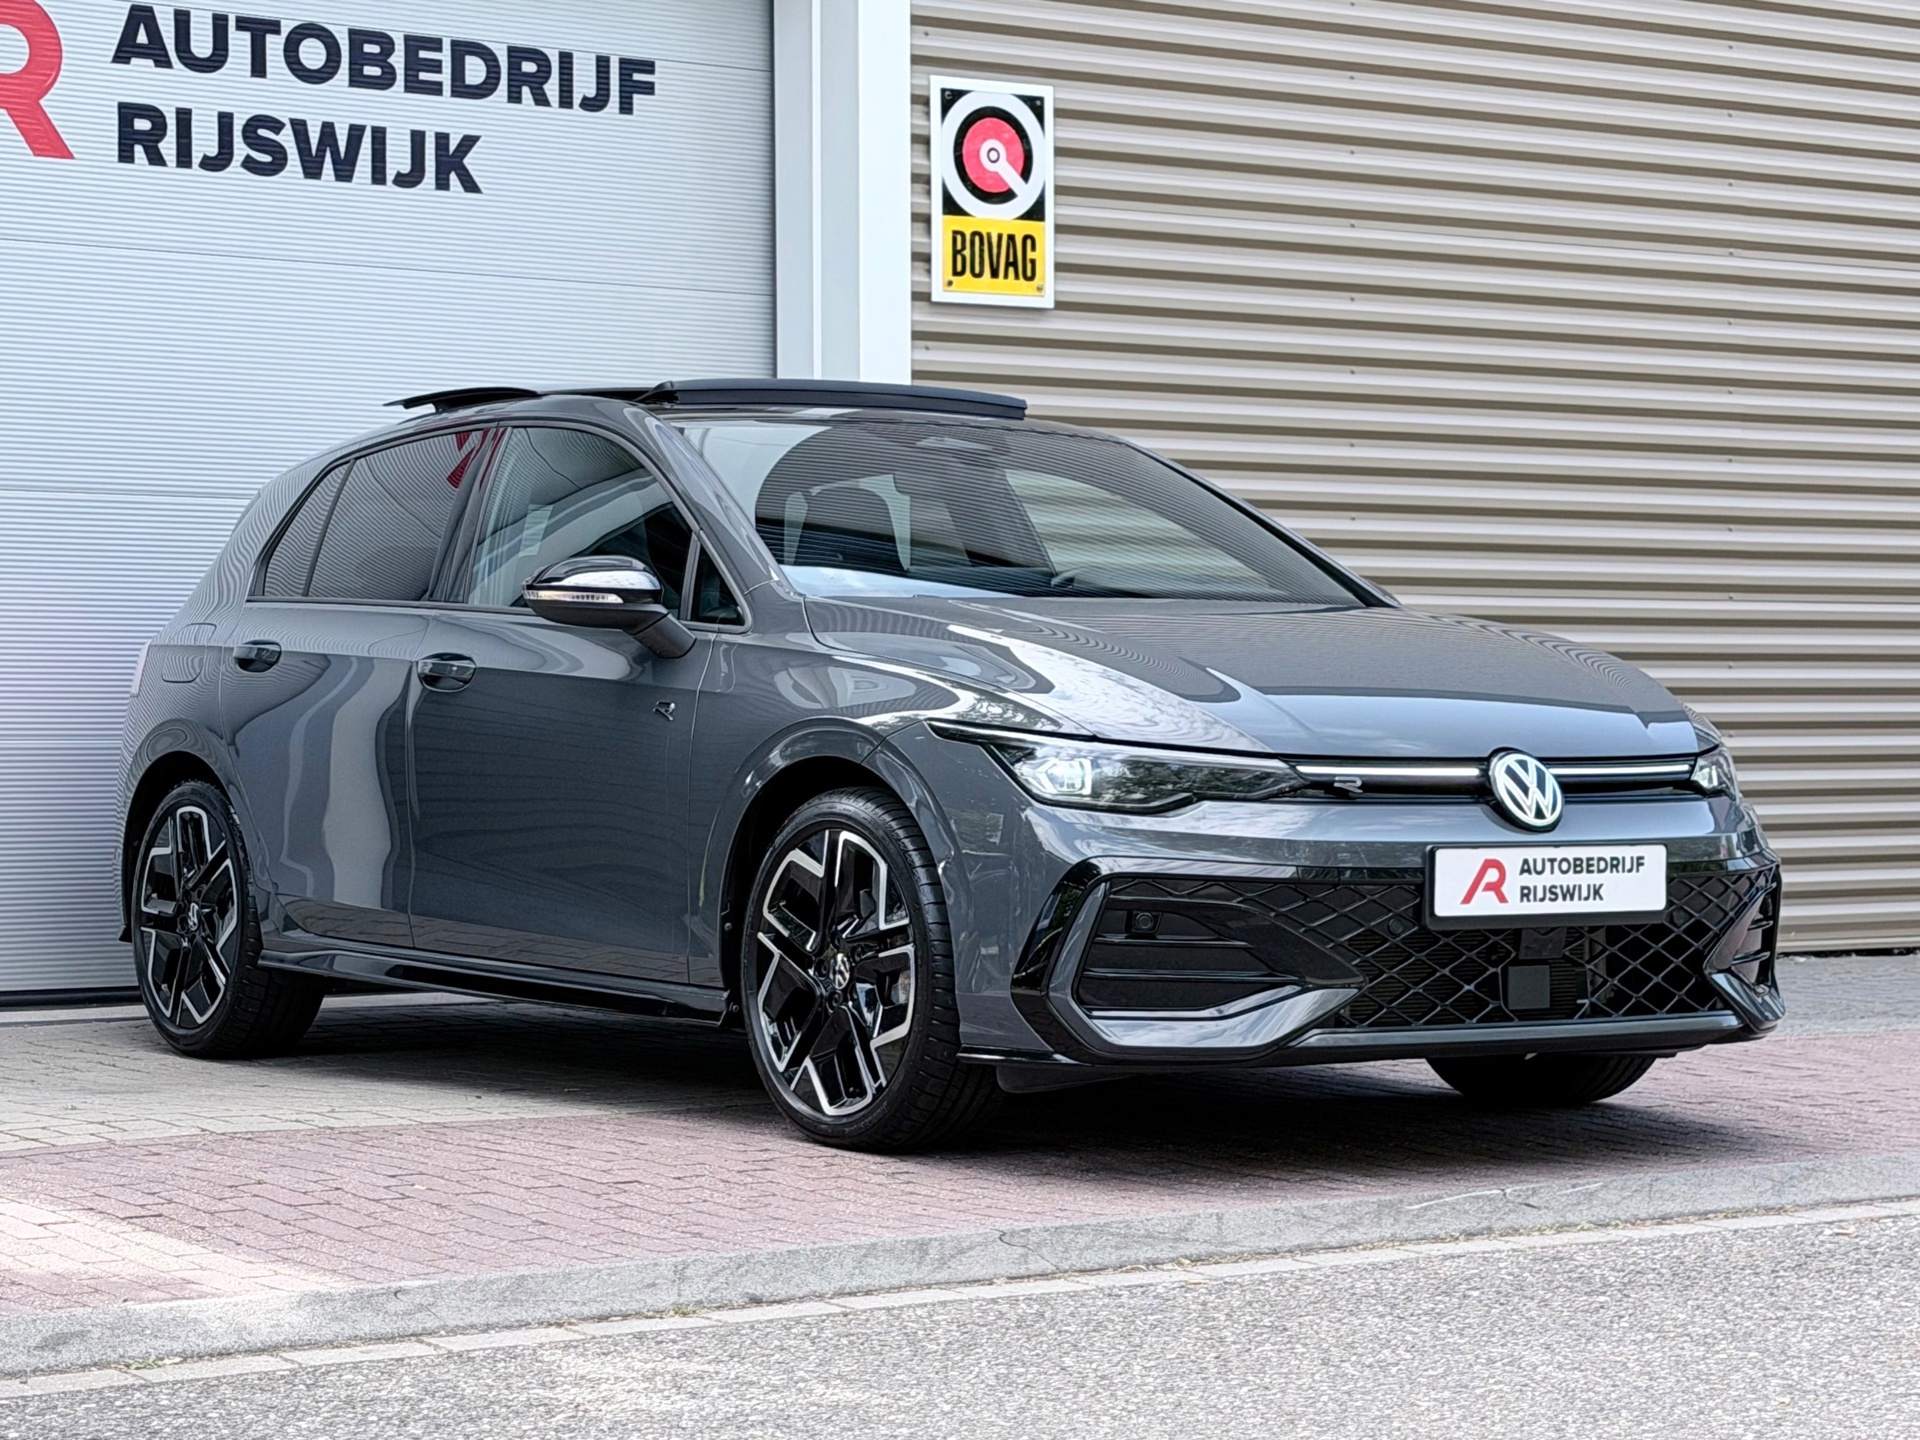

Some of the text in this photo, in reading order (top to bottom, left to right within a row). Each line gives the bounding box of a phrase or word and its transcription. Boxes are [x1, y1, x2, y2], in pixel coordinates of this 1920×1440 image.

[111, 4, 656, 116] AUTOBEDRIJF
[117, 101, 484, 194] RIJSWIJK
[951, 230, 1037, 282] BOVAG
[1519, 856, 1645, 876] AUTOBEDRIJF
[1519, 884, 1604, 903] RIJSWIJK
